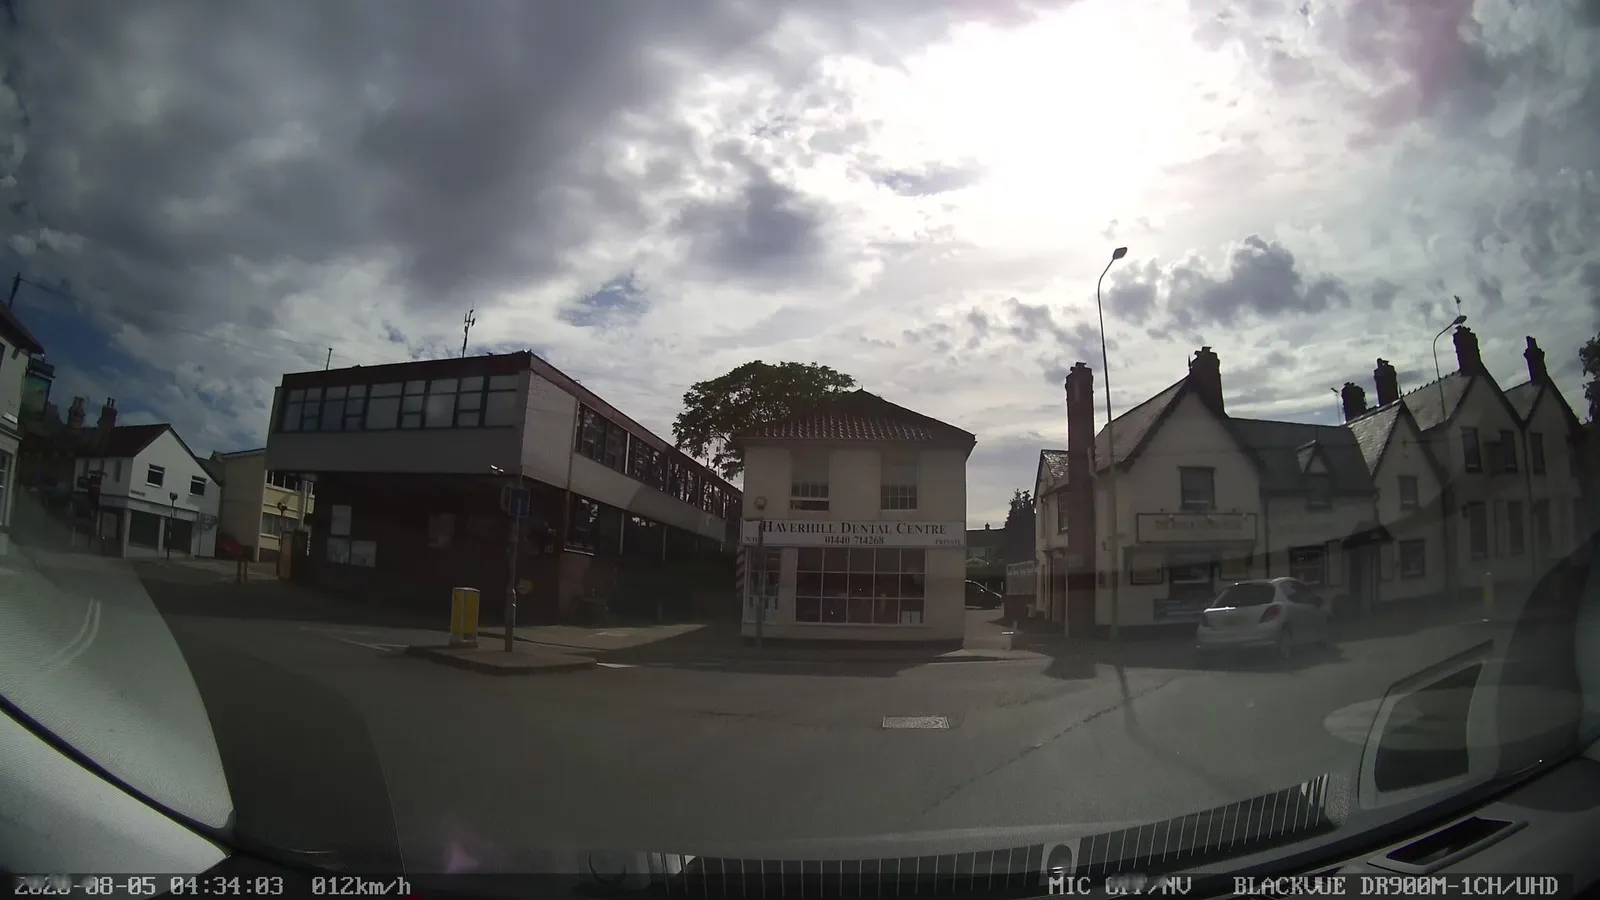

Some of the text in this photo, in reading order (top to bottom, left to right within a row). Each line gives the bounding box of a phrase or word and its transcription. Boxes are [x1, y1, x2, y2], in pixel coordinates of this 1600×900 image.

[763, 521, 946, 534] HAVERHILL DENTAL CENTRE
[825, 536, 885, 545] 01440 714268
